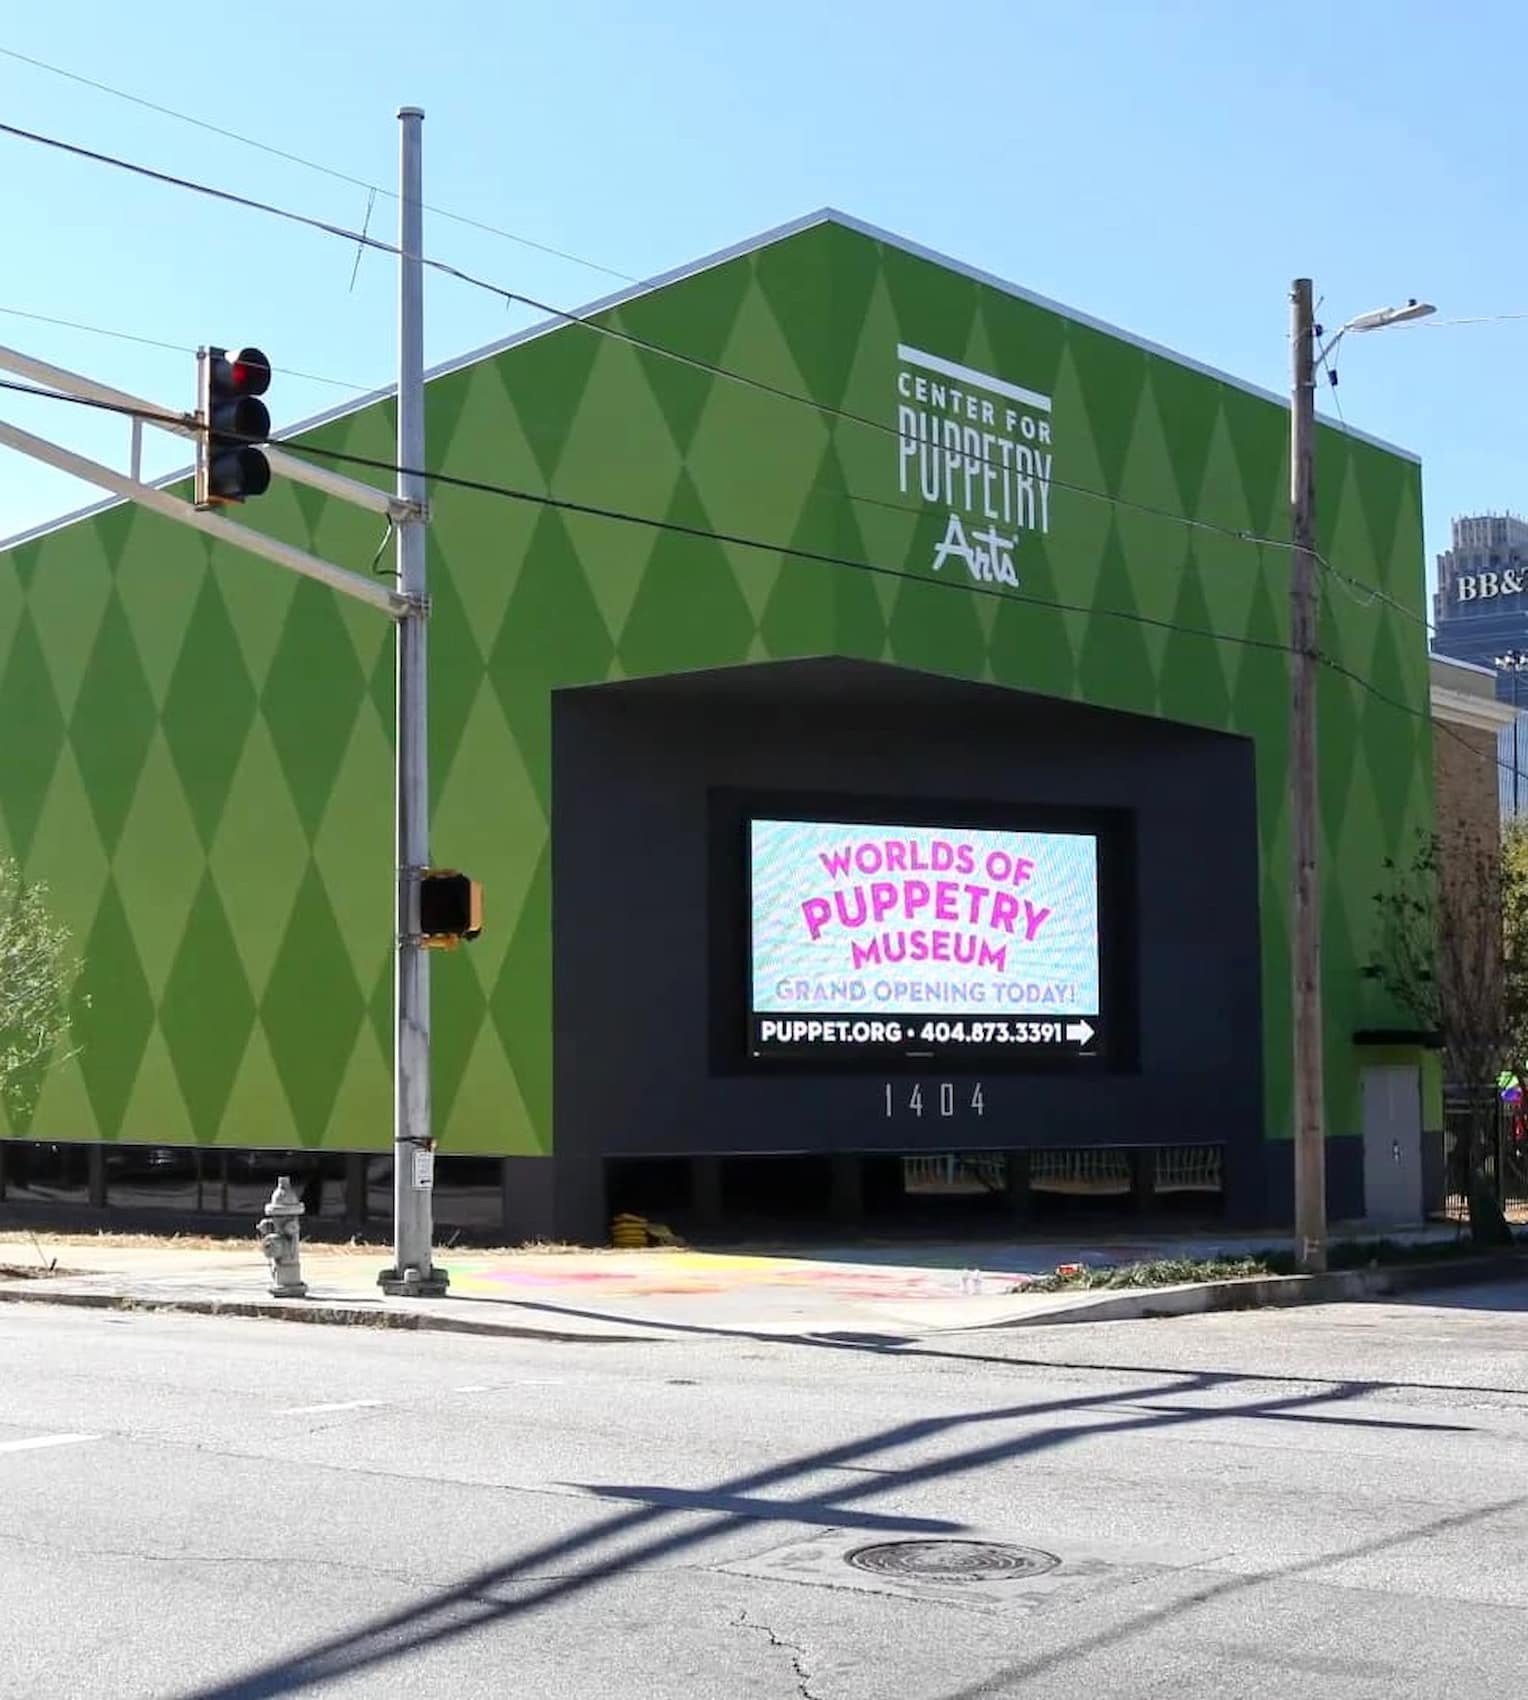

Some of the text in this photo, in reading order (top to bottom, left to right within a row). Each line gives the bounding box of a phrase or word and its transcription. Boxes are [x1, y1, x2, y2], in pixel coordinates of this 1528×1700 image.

[898, 371, 1051, 445] CENTER FOR
[898, 403, 1051, 534] PUPPETRY
[932, 513, 1019, 588] Arts
[819, 839, 1034, 887] WORLDS OF
[801, 879, 1051, 942] PUPPETRY
[851, 930, 1008, 973] MUSEUM
[775, 979, 1076, 1004] GRAND OPENING TODAY!
[761, 1020, 1062, 1043] PUPPET.ORG 404.873.3391
[884, 1082, 985, 1118] 1404
